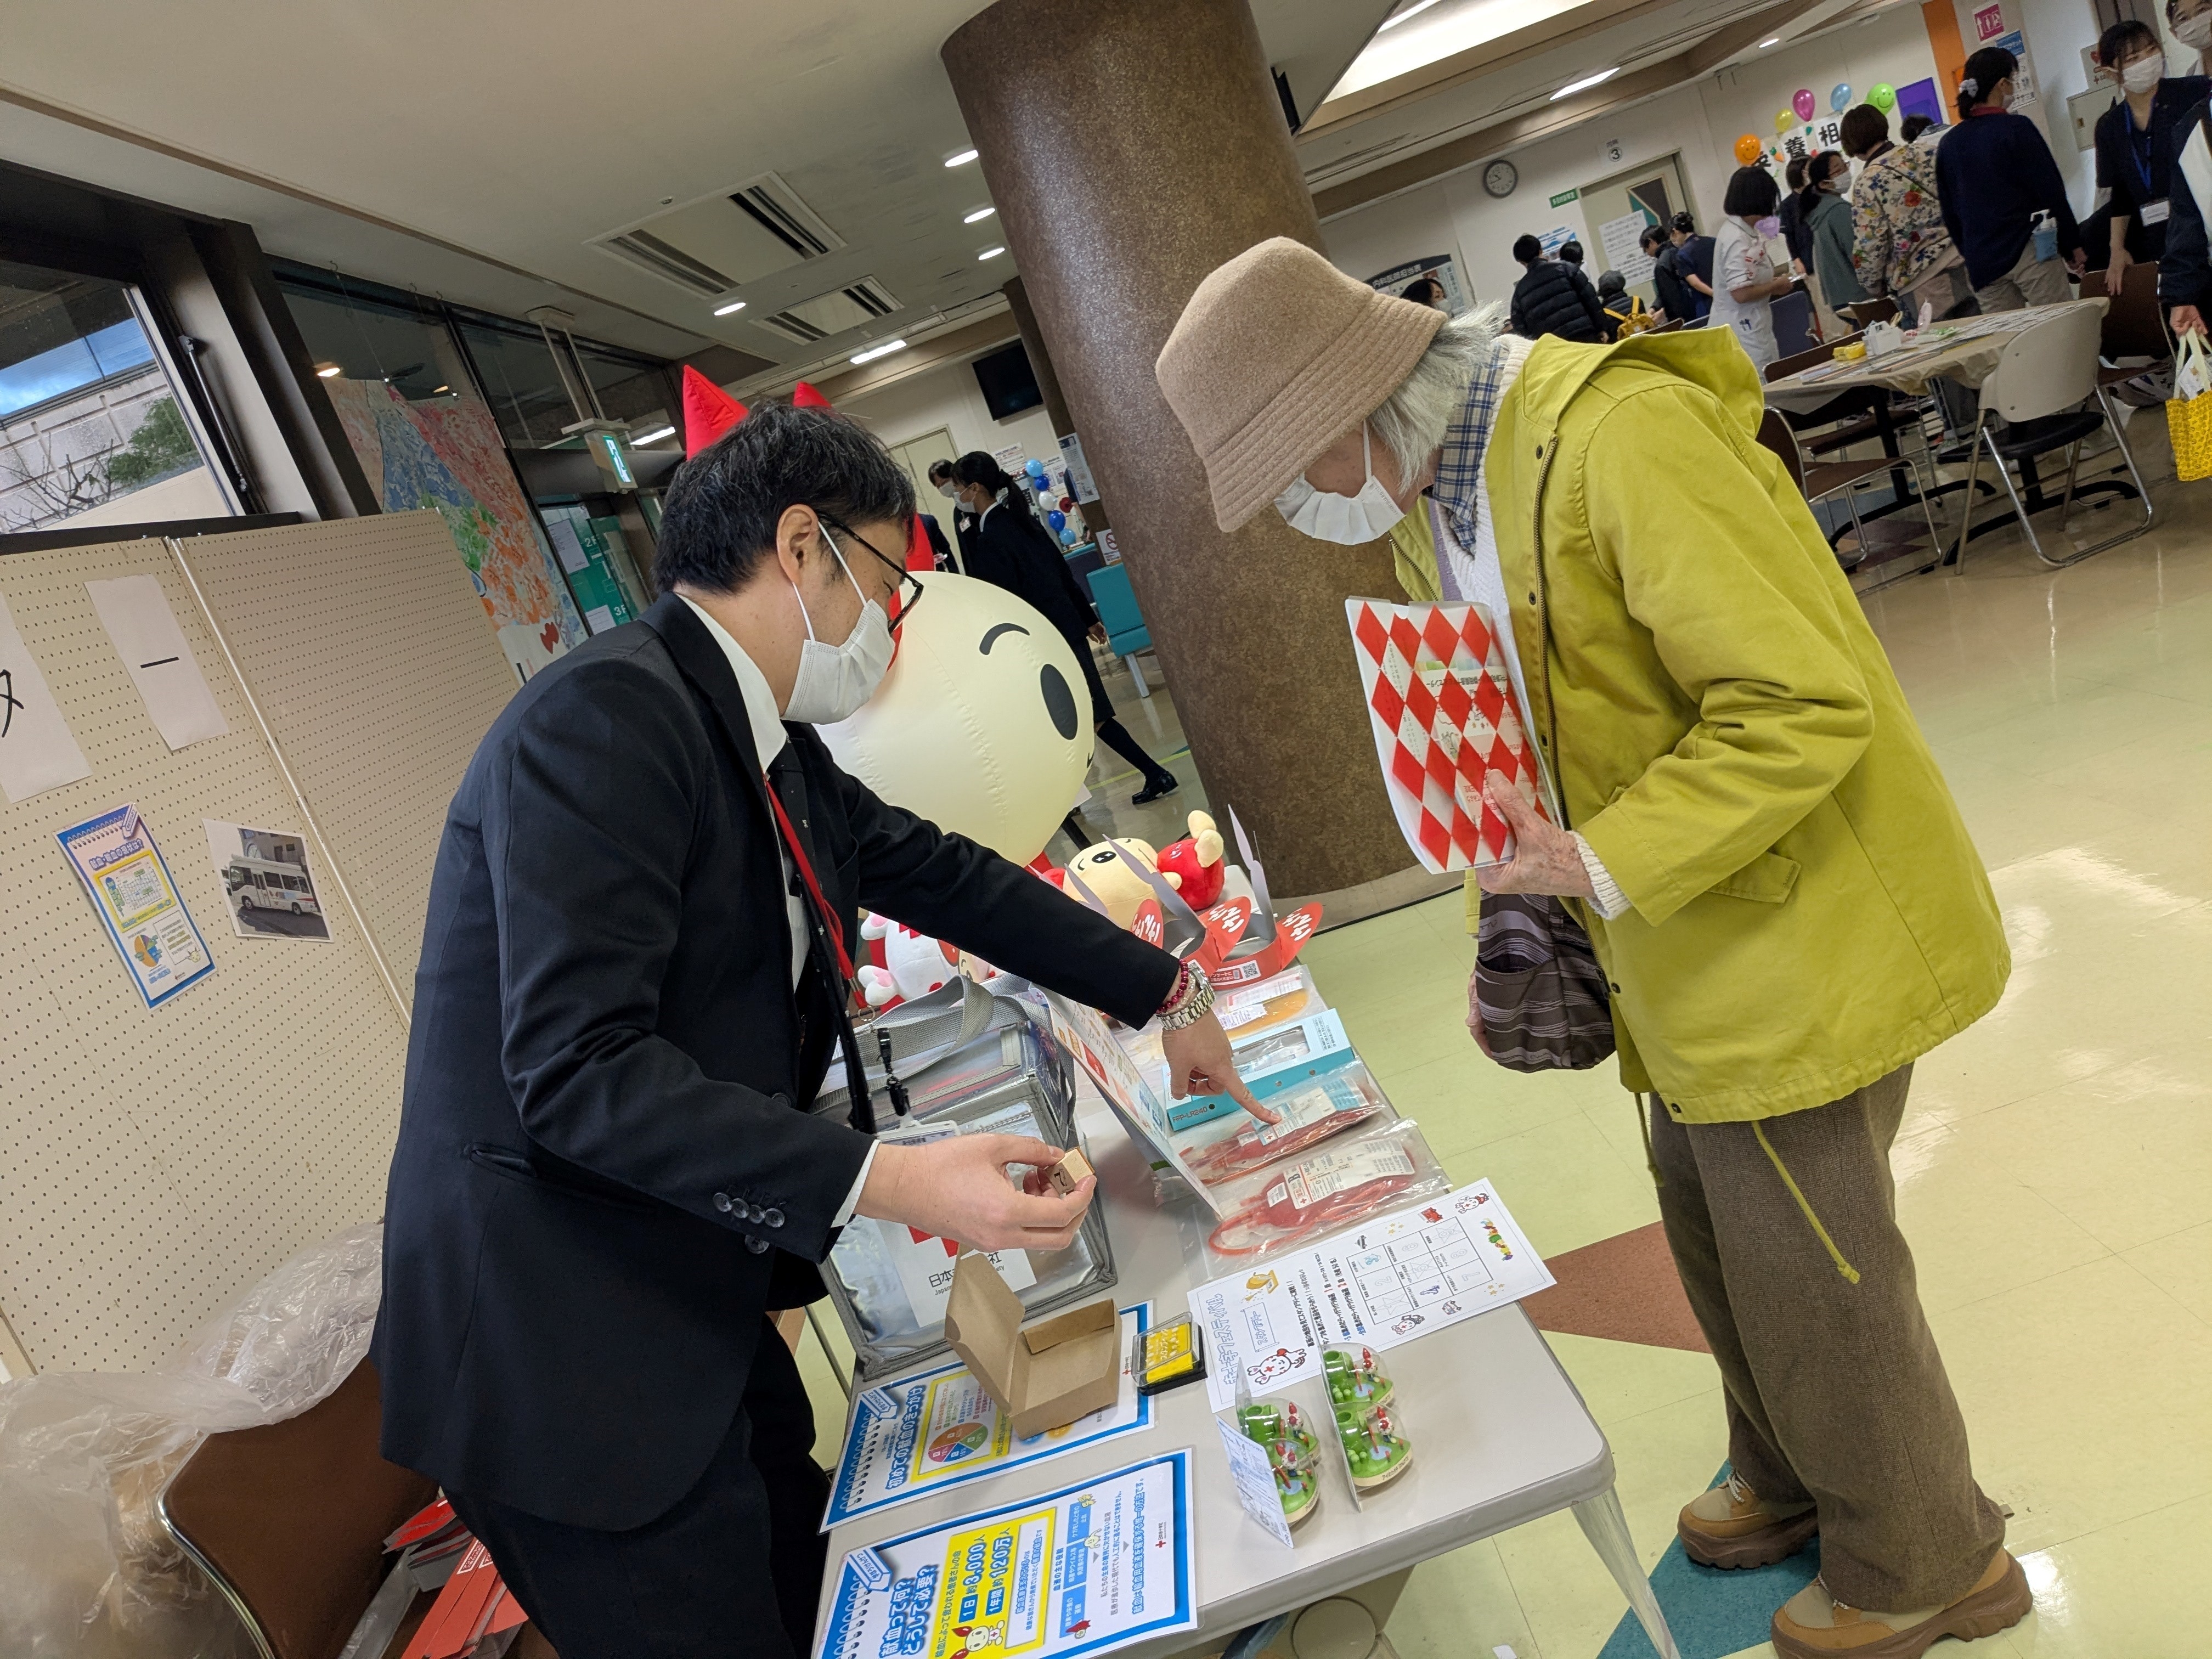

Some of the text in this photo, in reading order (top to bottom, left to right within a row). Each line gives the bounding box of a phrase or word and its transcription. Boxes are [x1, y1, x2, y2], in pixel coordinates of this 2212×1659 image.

[1288, 1173, 1300, 1183] B
[1206, 1293, 1240, 1385] 赤十字フェスティバル
[888, 1386, 927, 1487] 初めての献血のきっかけ
[879, 1580, 912, 1656] 献血って何?
[902, 1567, 935, 1654] どうして必要?
